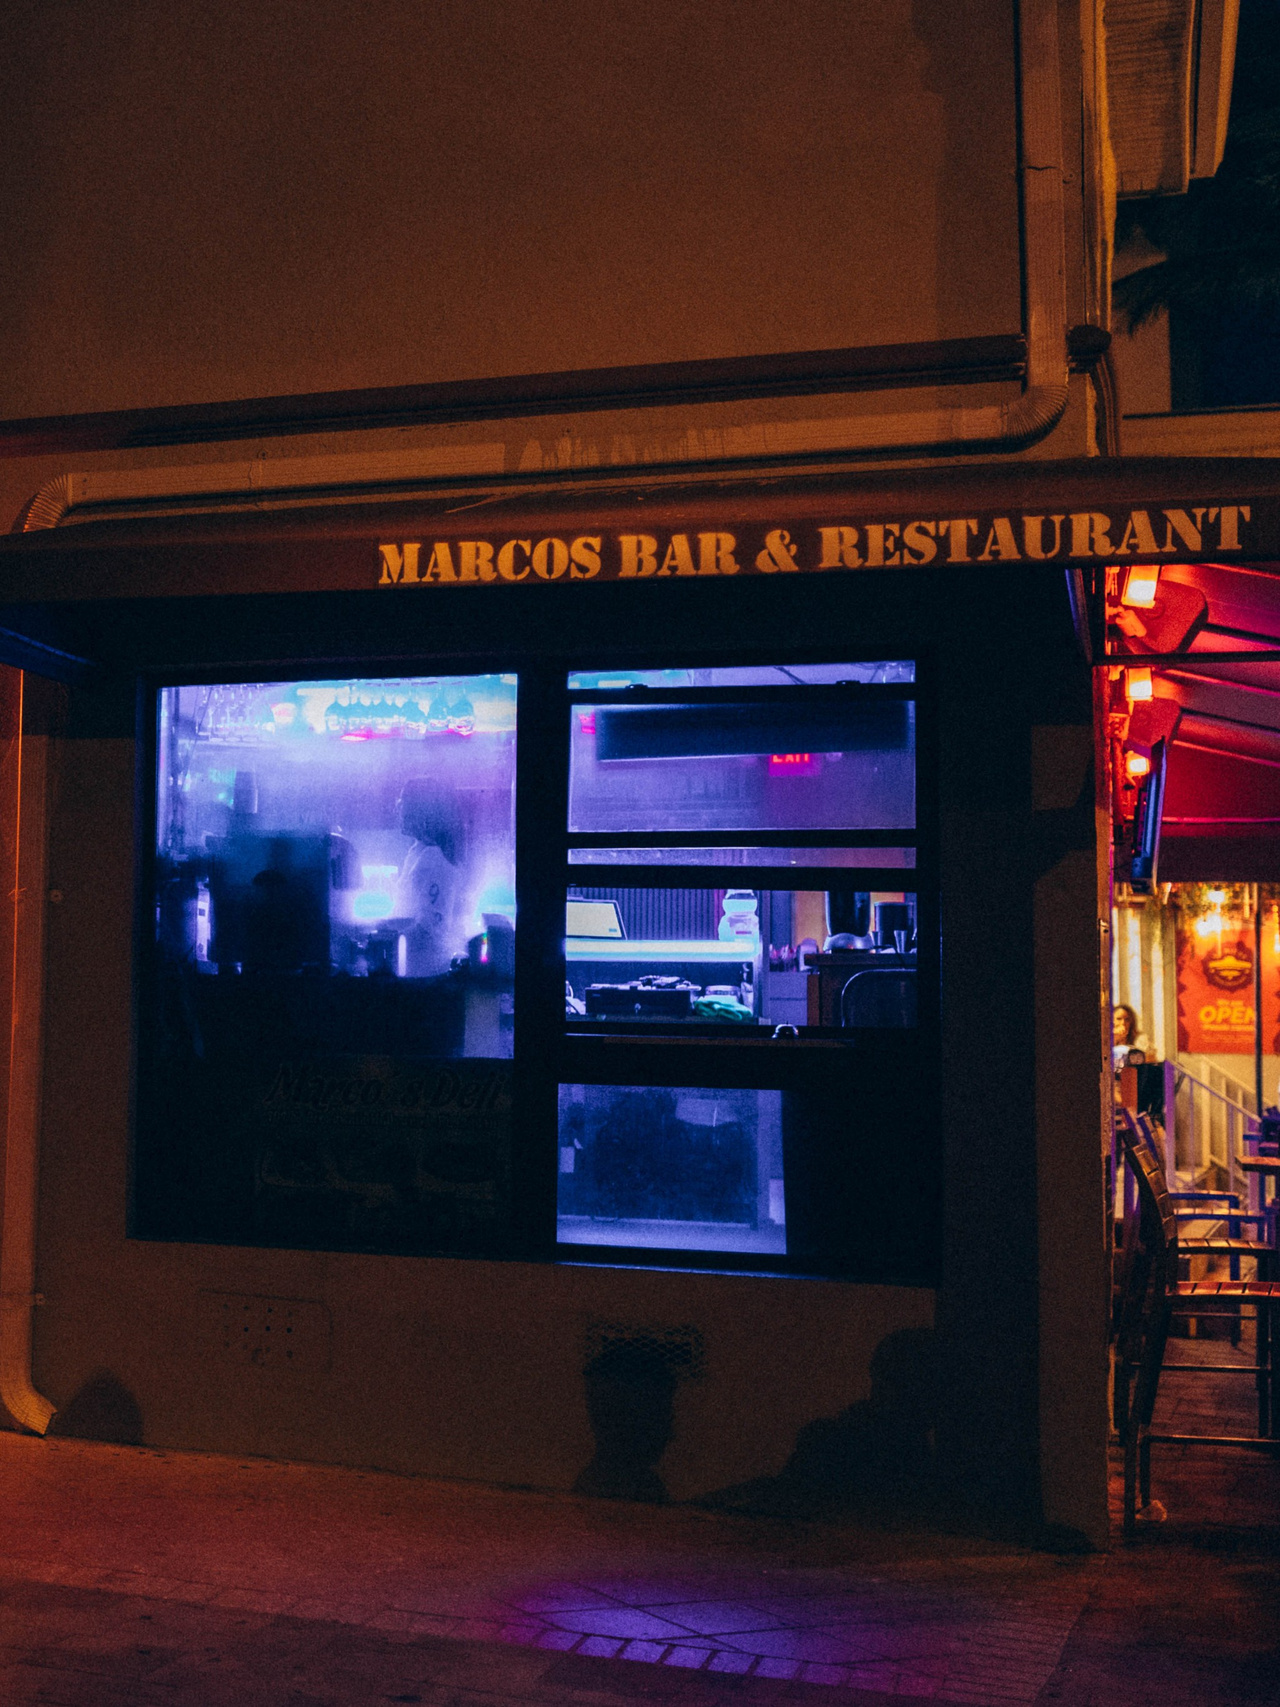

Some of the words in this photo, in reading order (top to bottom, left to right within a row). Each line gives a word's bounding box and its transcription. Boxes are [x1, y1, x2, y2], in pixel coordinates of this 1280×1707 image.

[378, 536, 602, 584] MARCOS
[618, 531, 740, 578] BAR
[756, 529, 799, 574] &
[817, 505, 1251, 569] RESTAURANT
